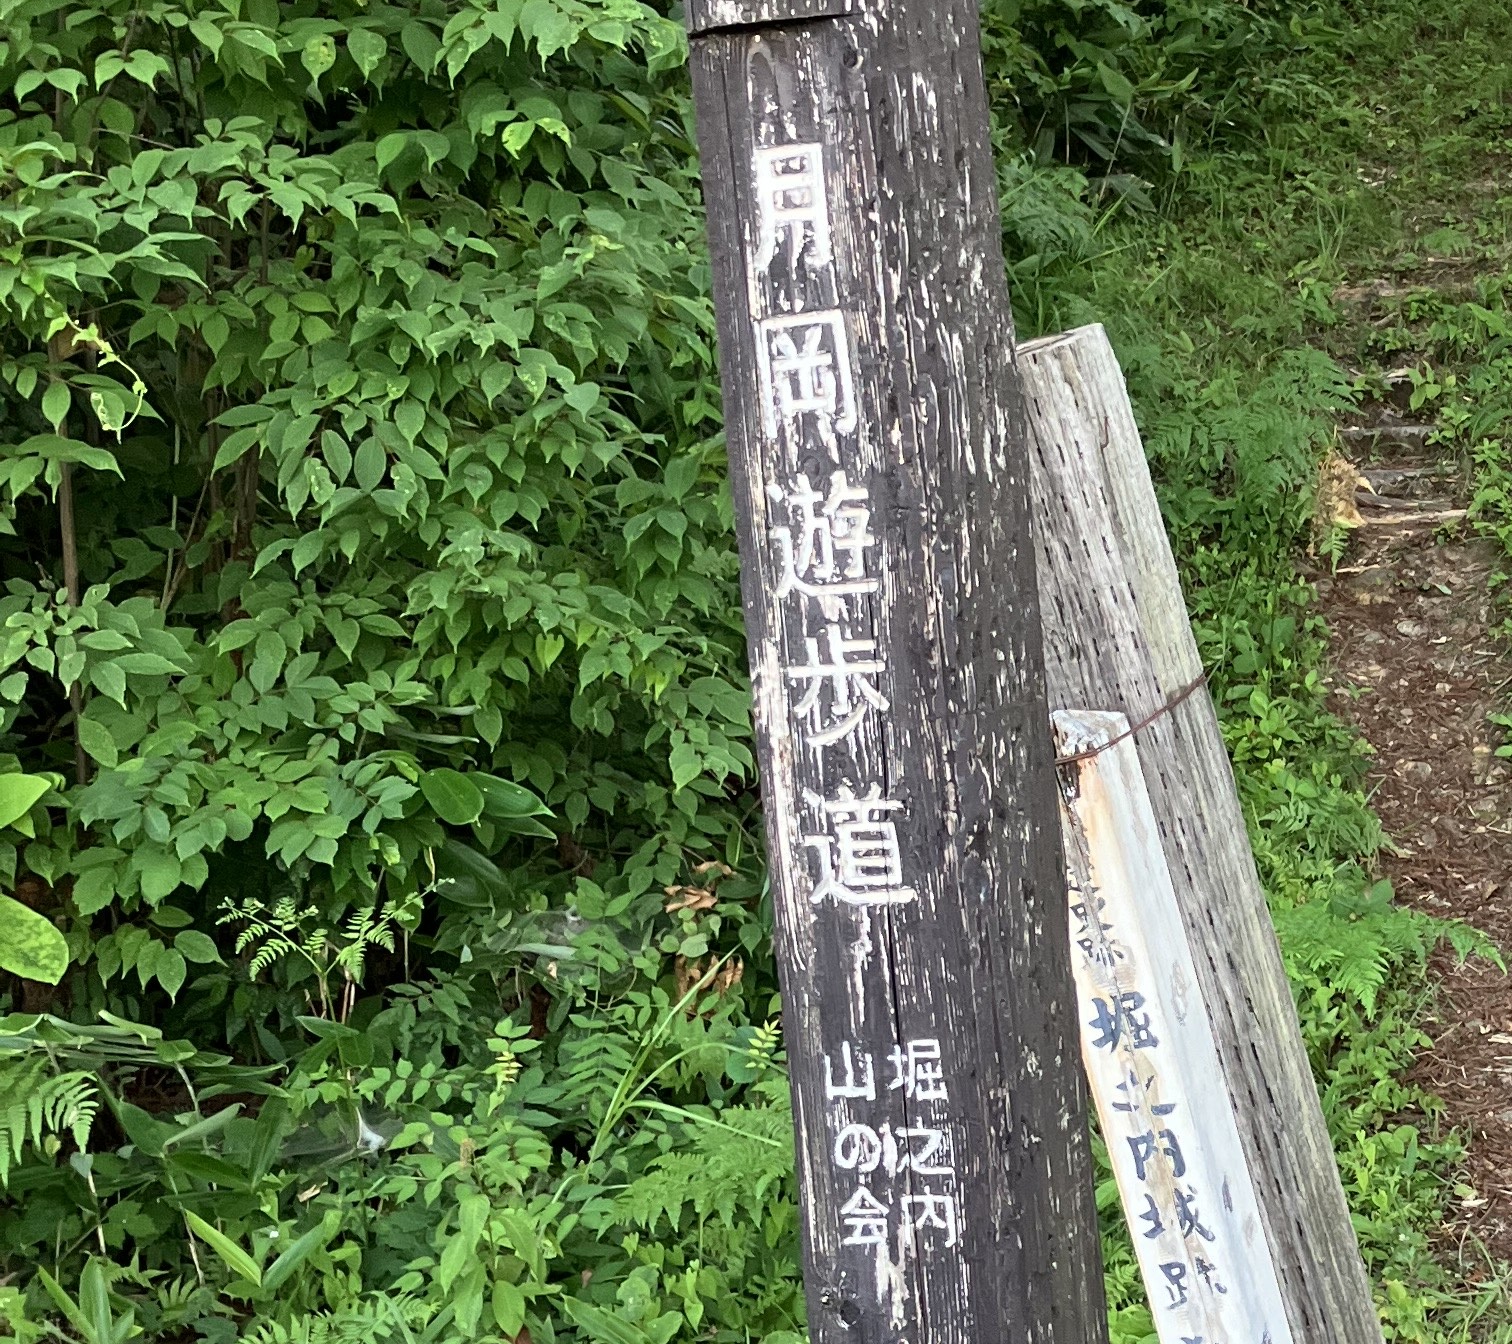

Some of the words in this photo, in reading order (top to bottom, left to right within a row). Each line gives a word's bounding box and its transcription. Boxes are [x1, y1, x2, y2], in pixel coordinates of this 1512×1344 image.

[752, 143, 917, 906] 月岡遊歩道
[822, 1040, 890, 1246] 山の会
[886, 1039, 957, 1248] 堀之内
